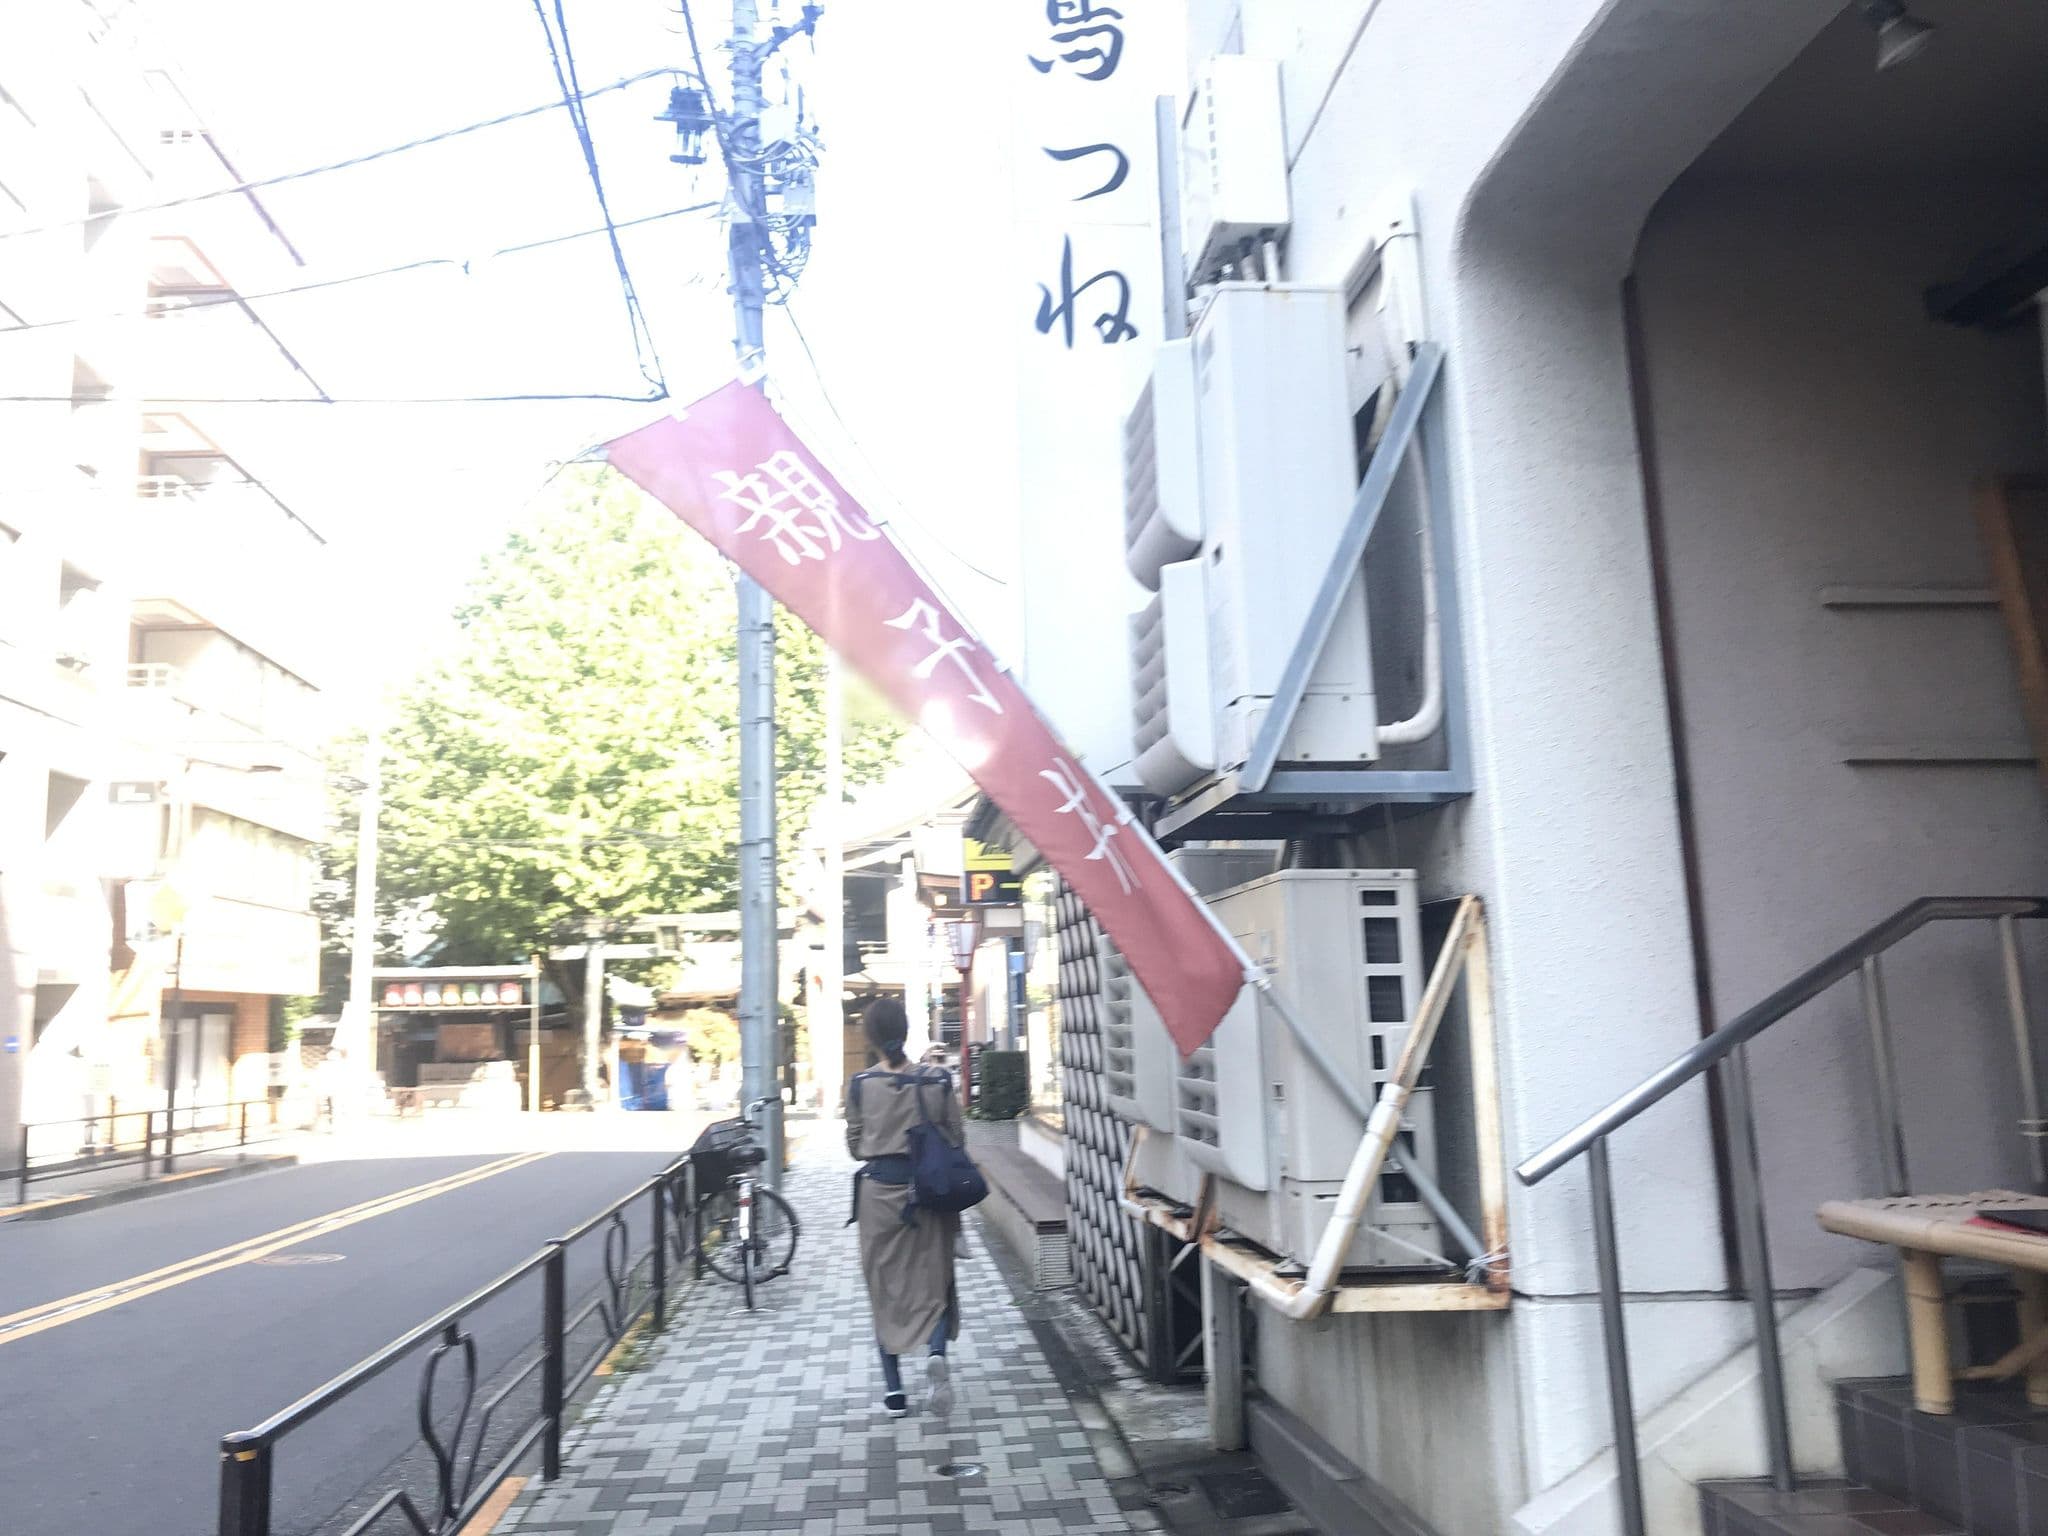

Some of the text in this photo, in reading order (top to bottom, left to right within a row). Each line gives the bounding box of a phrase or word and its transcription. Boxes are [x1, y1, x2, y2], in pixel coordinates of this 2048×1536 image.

[711, 450, 1142, 896] 親子丼
[970, 873, 994, 901] P
